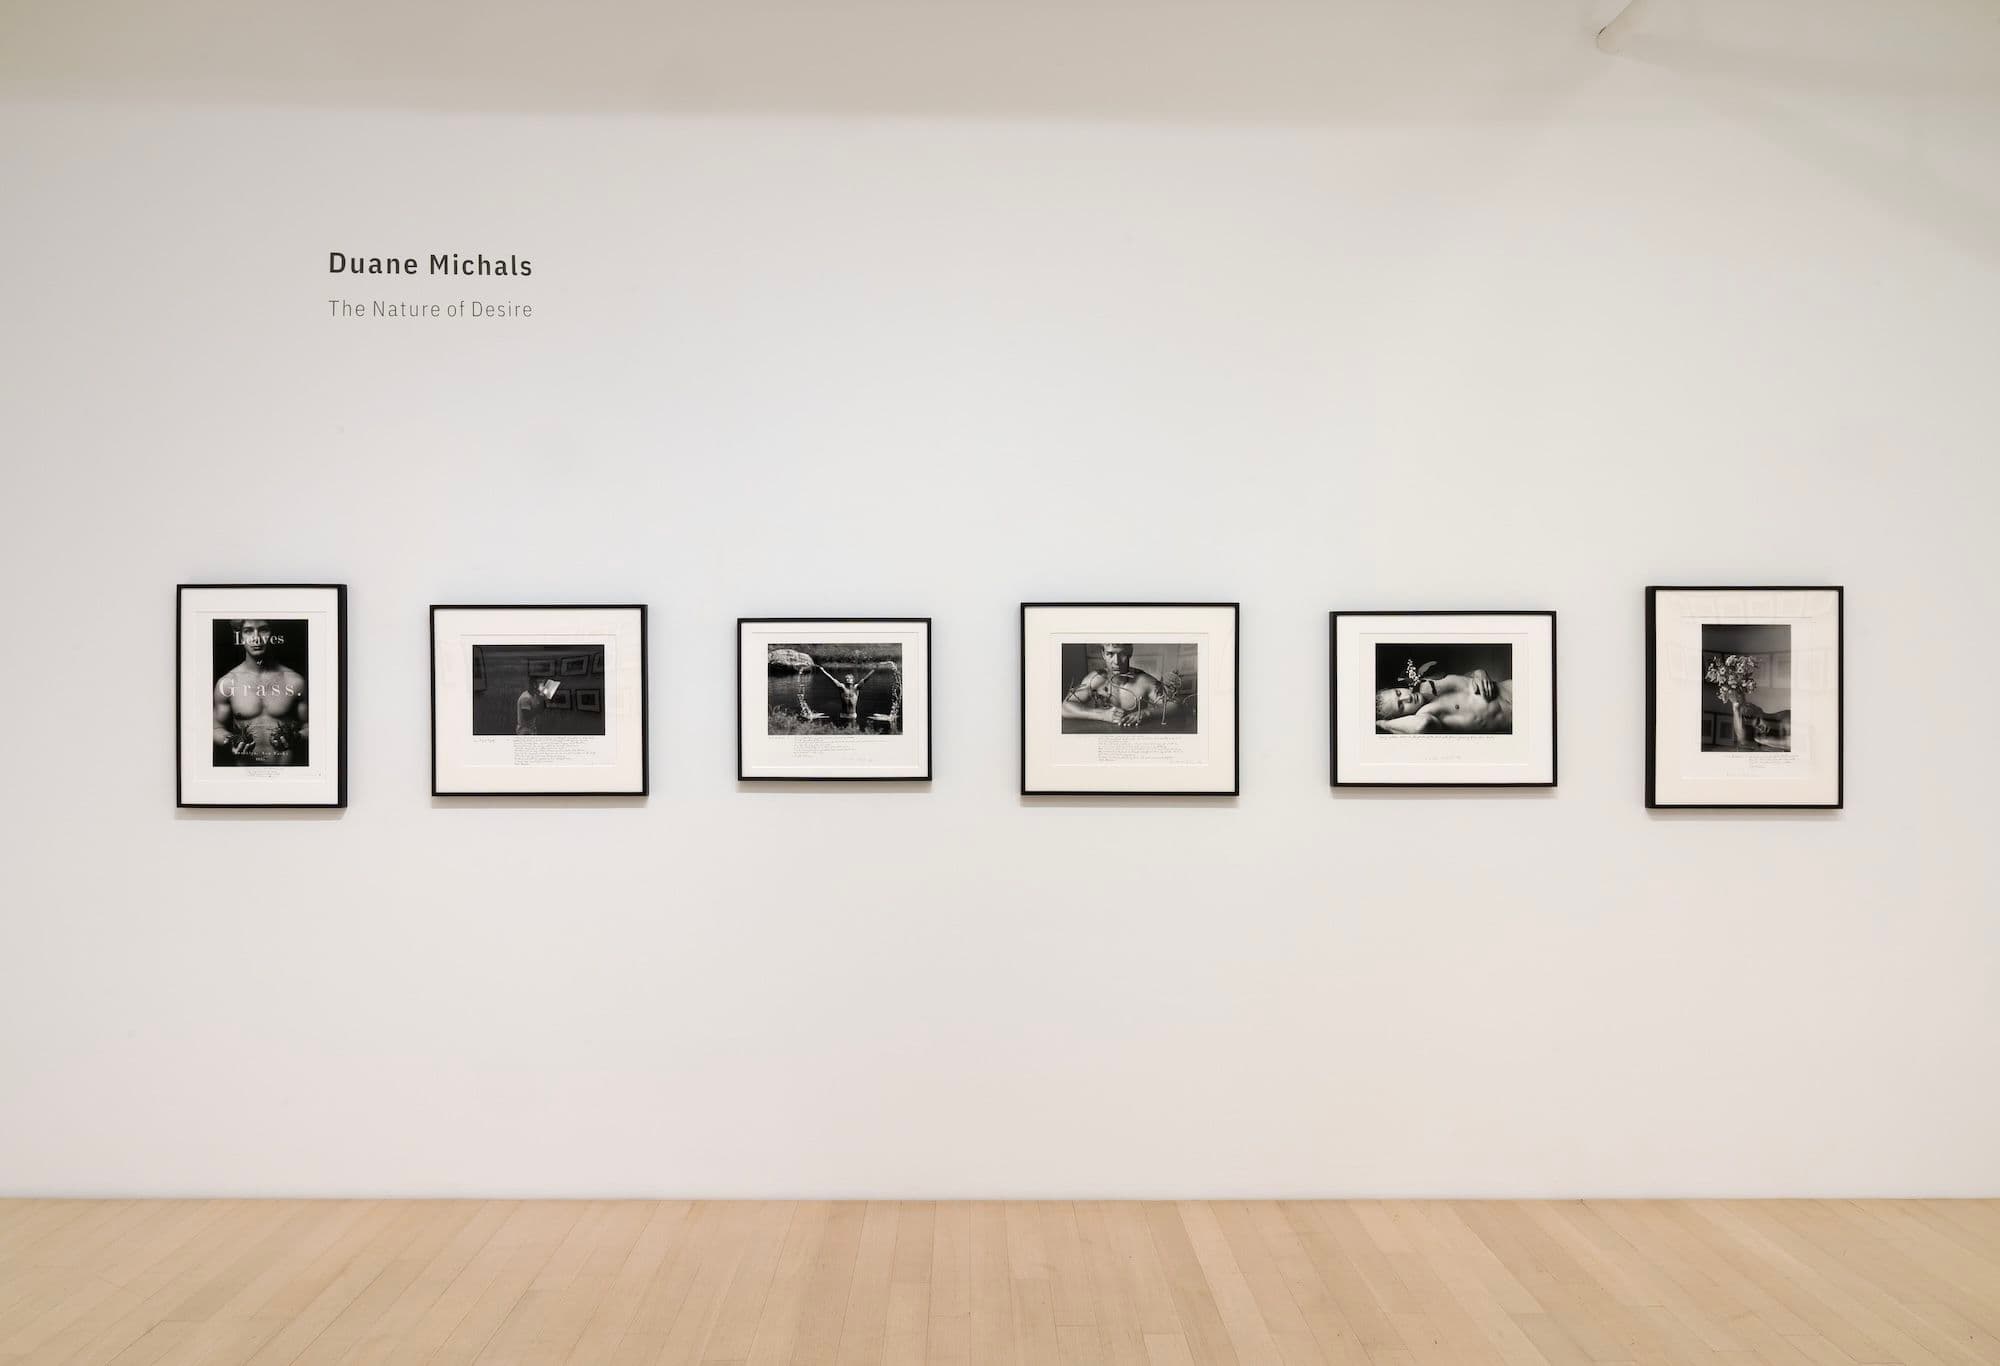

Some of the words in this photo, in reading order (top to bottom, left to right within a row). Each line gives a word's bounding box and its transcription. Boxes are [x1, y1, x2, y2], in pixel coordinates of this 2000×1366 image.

[329, 251, 418, 275] Duane
[429, 253, 533, 277] Michals
[328, 300, 366, 318] The
[372, 300, 441, 318] Nature
[447, 299, 465, 318] of
[471, 300, 533, 318] Desire
[233, 630, 285, 646] Leaves
[218, 678, 302, 698] Grass.
